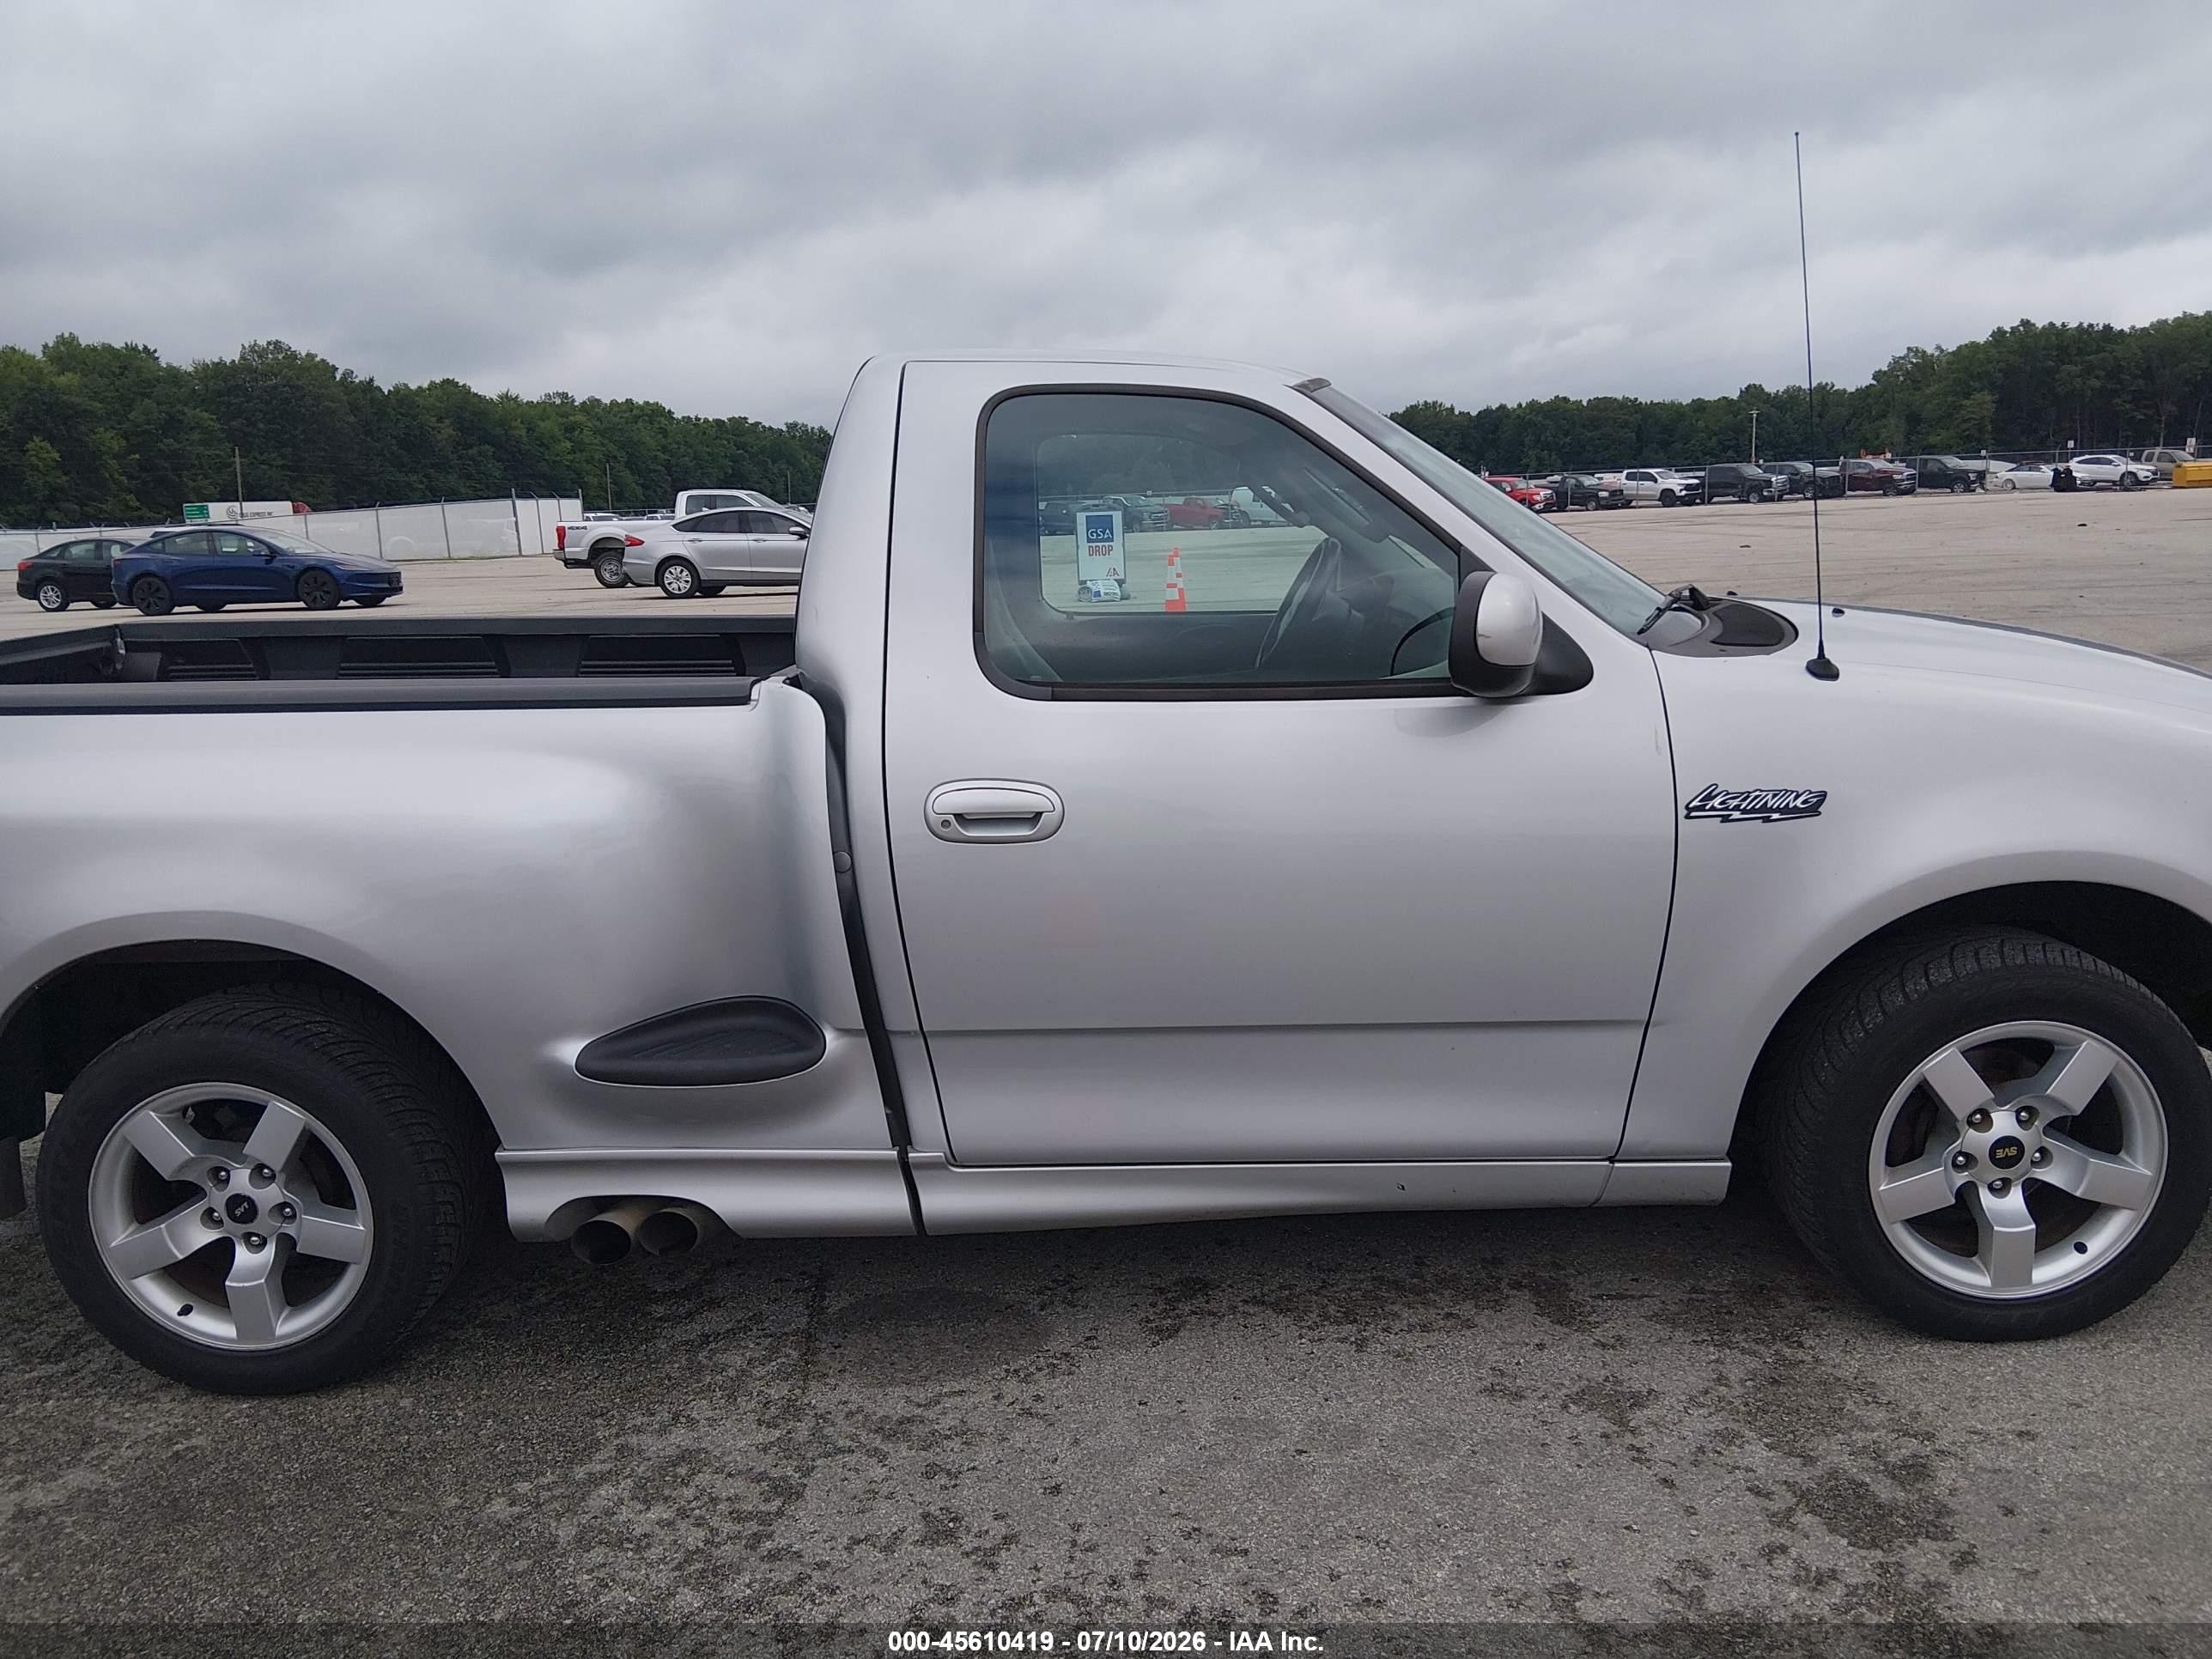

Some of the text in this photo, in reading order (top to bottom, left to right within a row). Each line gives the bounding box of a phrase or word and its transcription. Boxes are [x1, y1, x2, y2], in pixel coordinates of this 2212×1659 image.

[1087, 528, 1113, 539] GSA
[1088, 544, 1114, 556] DROP
[1686, 783, 1827, 811] LIGHTNING
[234, 1201, 249, 1217] SVT
